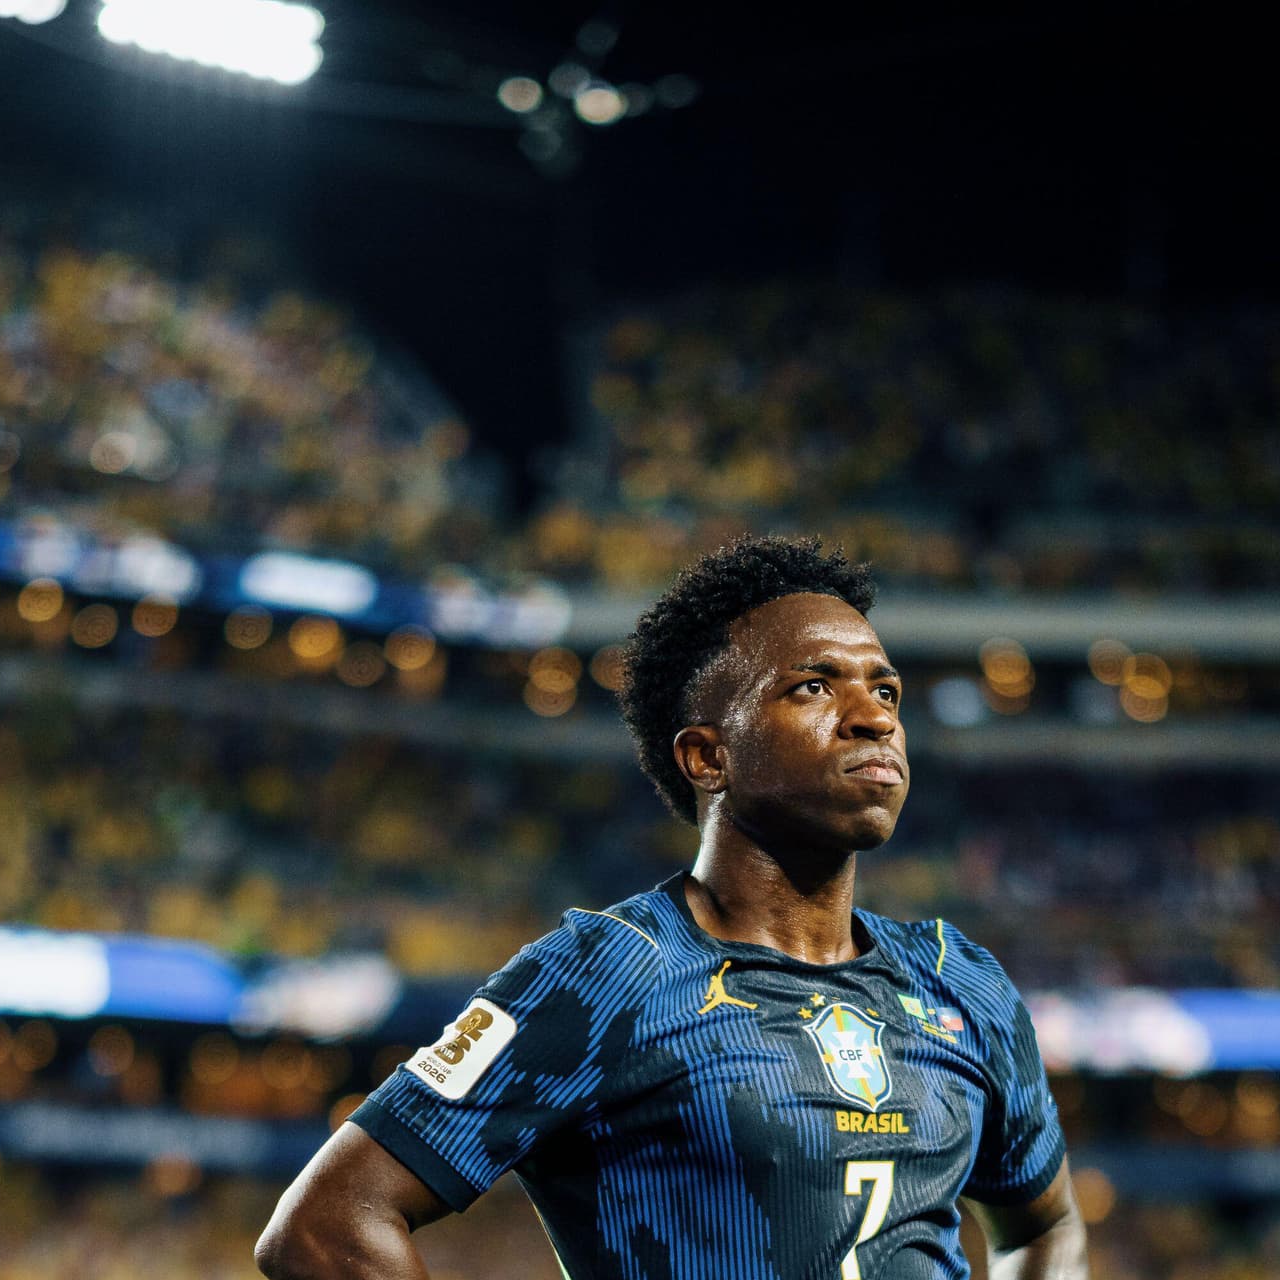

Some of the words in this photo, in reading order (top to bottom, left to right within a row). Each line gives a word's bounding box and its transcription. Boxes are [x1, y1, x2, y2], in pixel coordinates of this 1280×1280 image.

[838, 1049, 864, 1061] CBF
[417, 1060, 447, 1084] 2026
[835, 1111, 910, 1133] BRASIL
